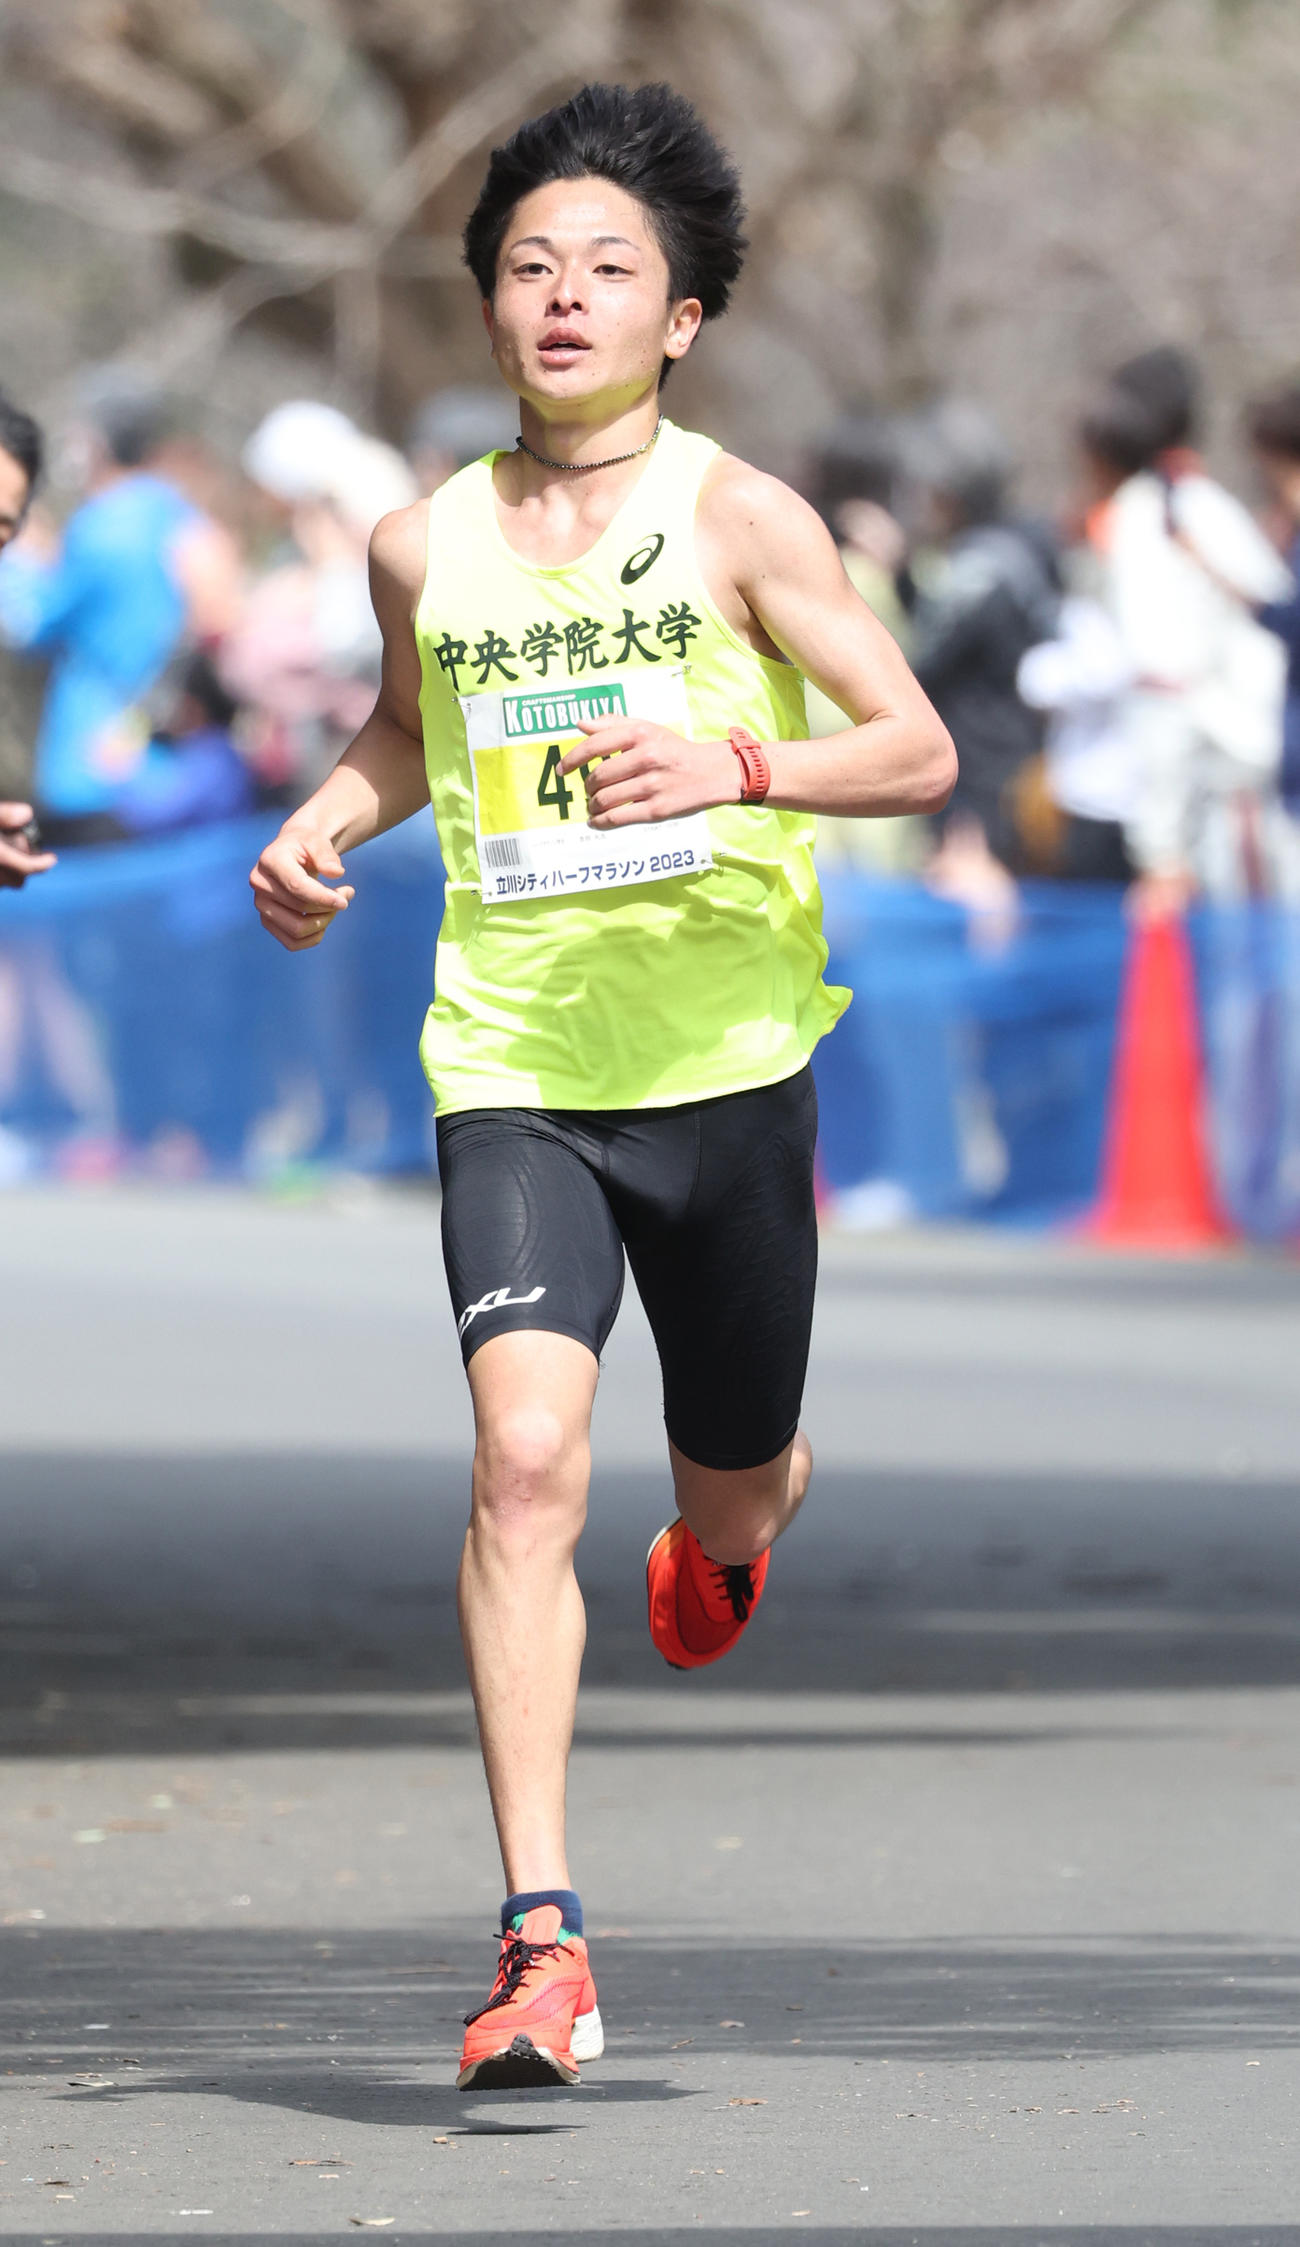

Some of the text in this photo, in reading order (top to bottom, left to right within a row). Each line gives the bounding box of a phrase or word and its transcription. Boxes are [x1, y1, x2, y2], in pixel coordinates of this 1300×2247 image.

[433, 601, 702, 692] 中央学院大学
[504, 695, 625, 734] KOTOBUKIYA
[496, 849, 695, 895] 立川シティハーフマラソン 2023
